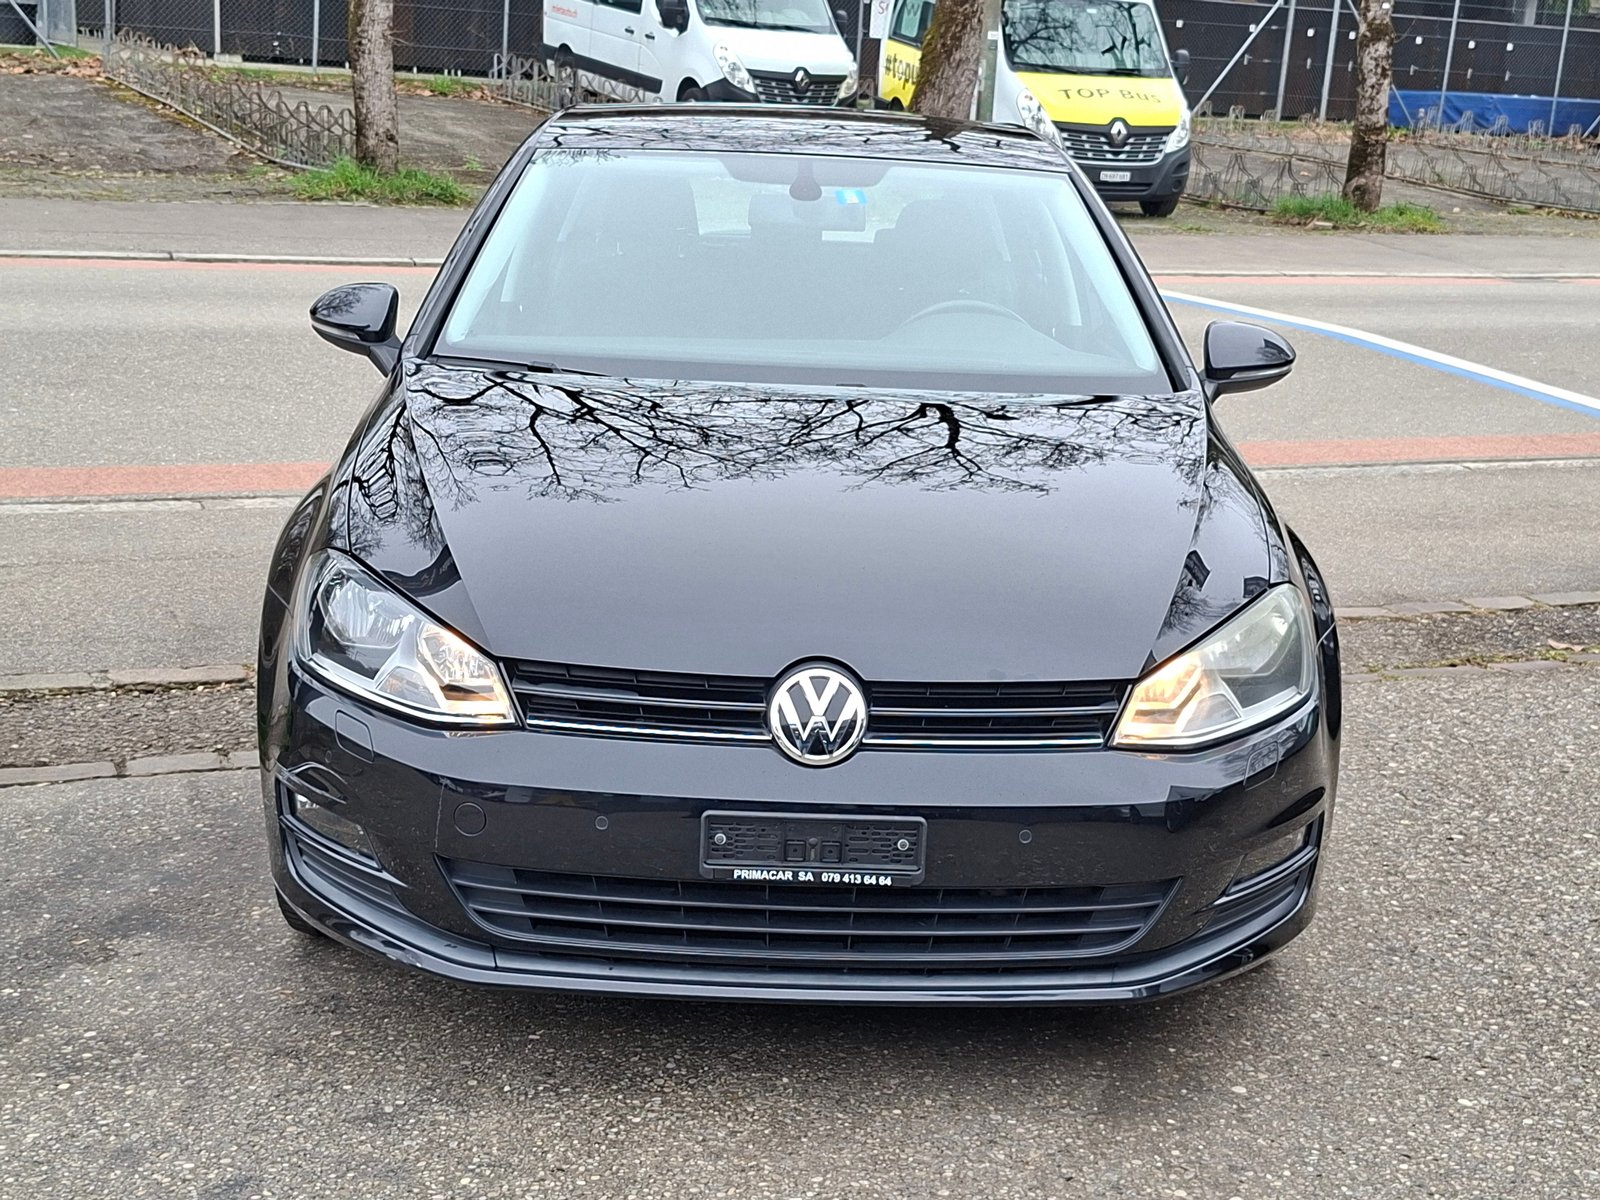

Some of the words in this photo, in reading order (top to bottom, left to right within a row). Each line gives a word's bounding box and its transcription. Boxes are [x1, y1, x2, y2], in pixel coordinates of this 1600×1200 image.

[1058, 88, 1110, 100] TOP
[733, 869, 793, 881] PRIMACAR
[798, 871, 814, 882] SA
[821, 872, 841, 883] 079
[842, 873, 862, 884] 413
[863, 875, 877, 885] 64
[878, 876, 892, 886] 64
